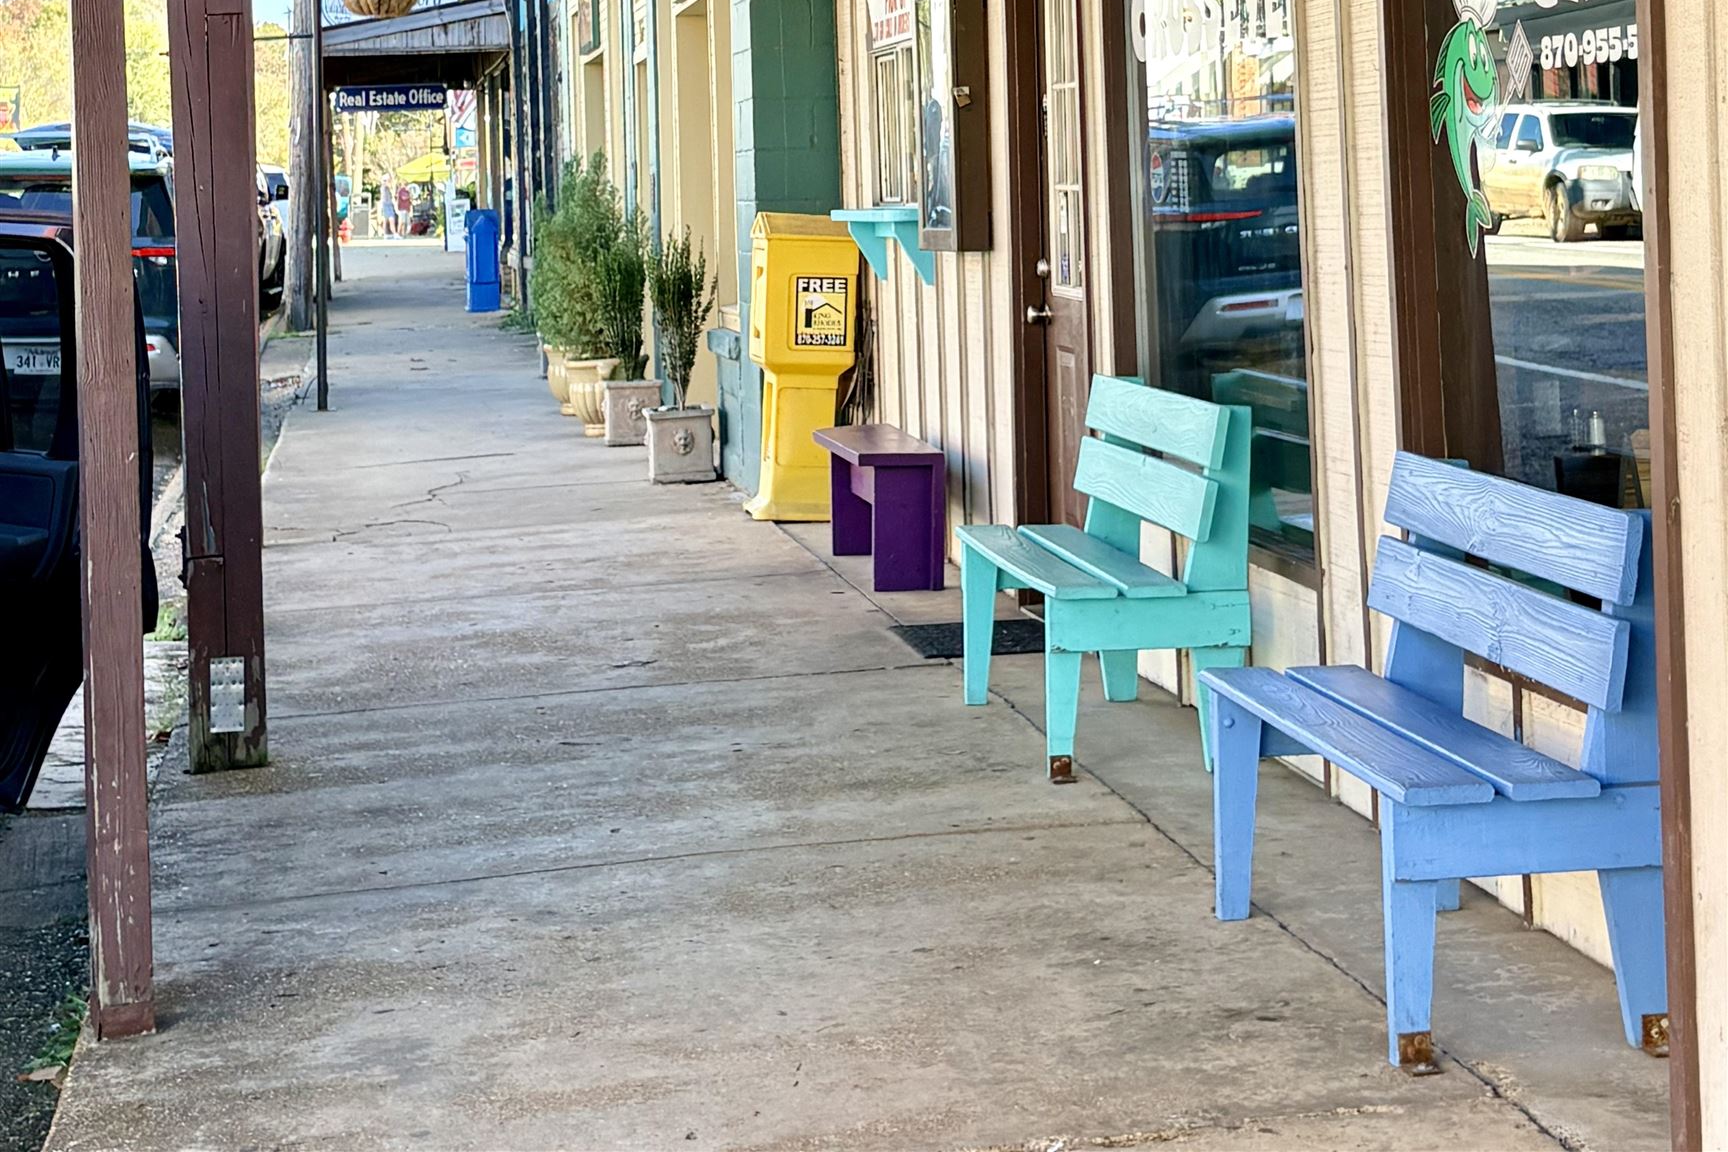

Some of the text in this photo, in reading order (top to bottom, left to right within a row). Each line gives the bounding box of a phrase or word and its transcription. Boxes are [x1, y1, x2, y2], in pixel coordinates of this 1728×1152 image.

[340, 89, 443, 107] Real Estate Office
[797, 278, 847, 293] FREE
